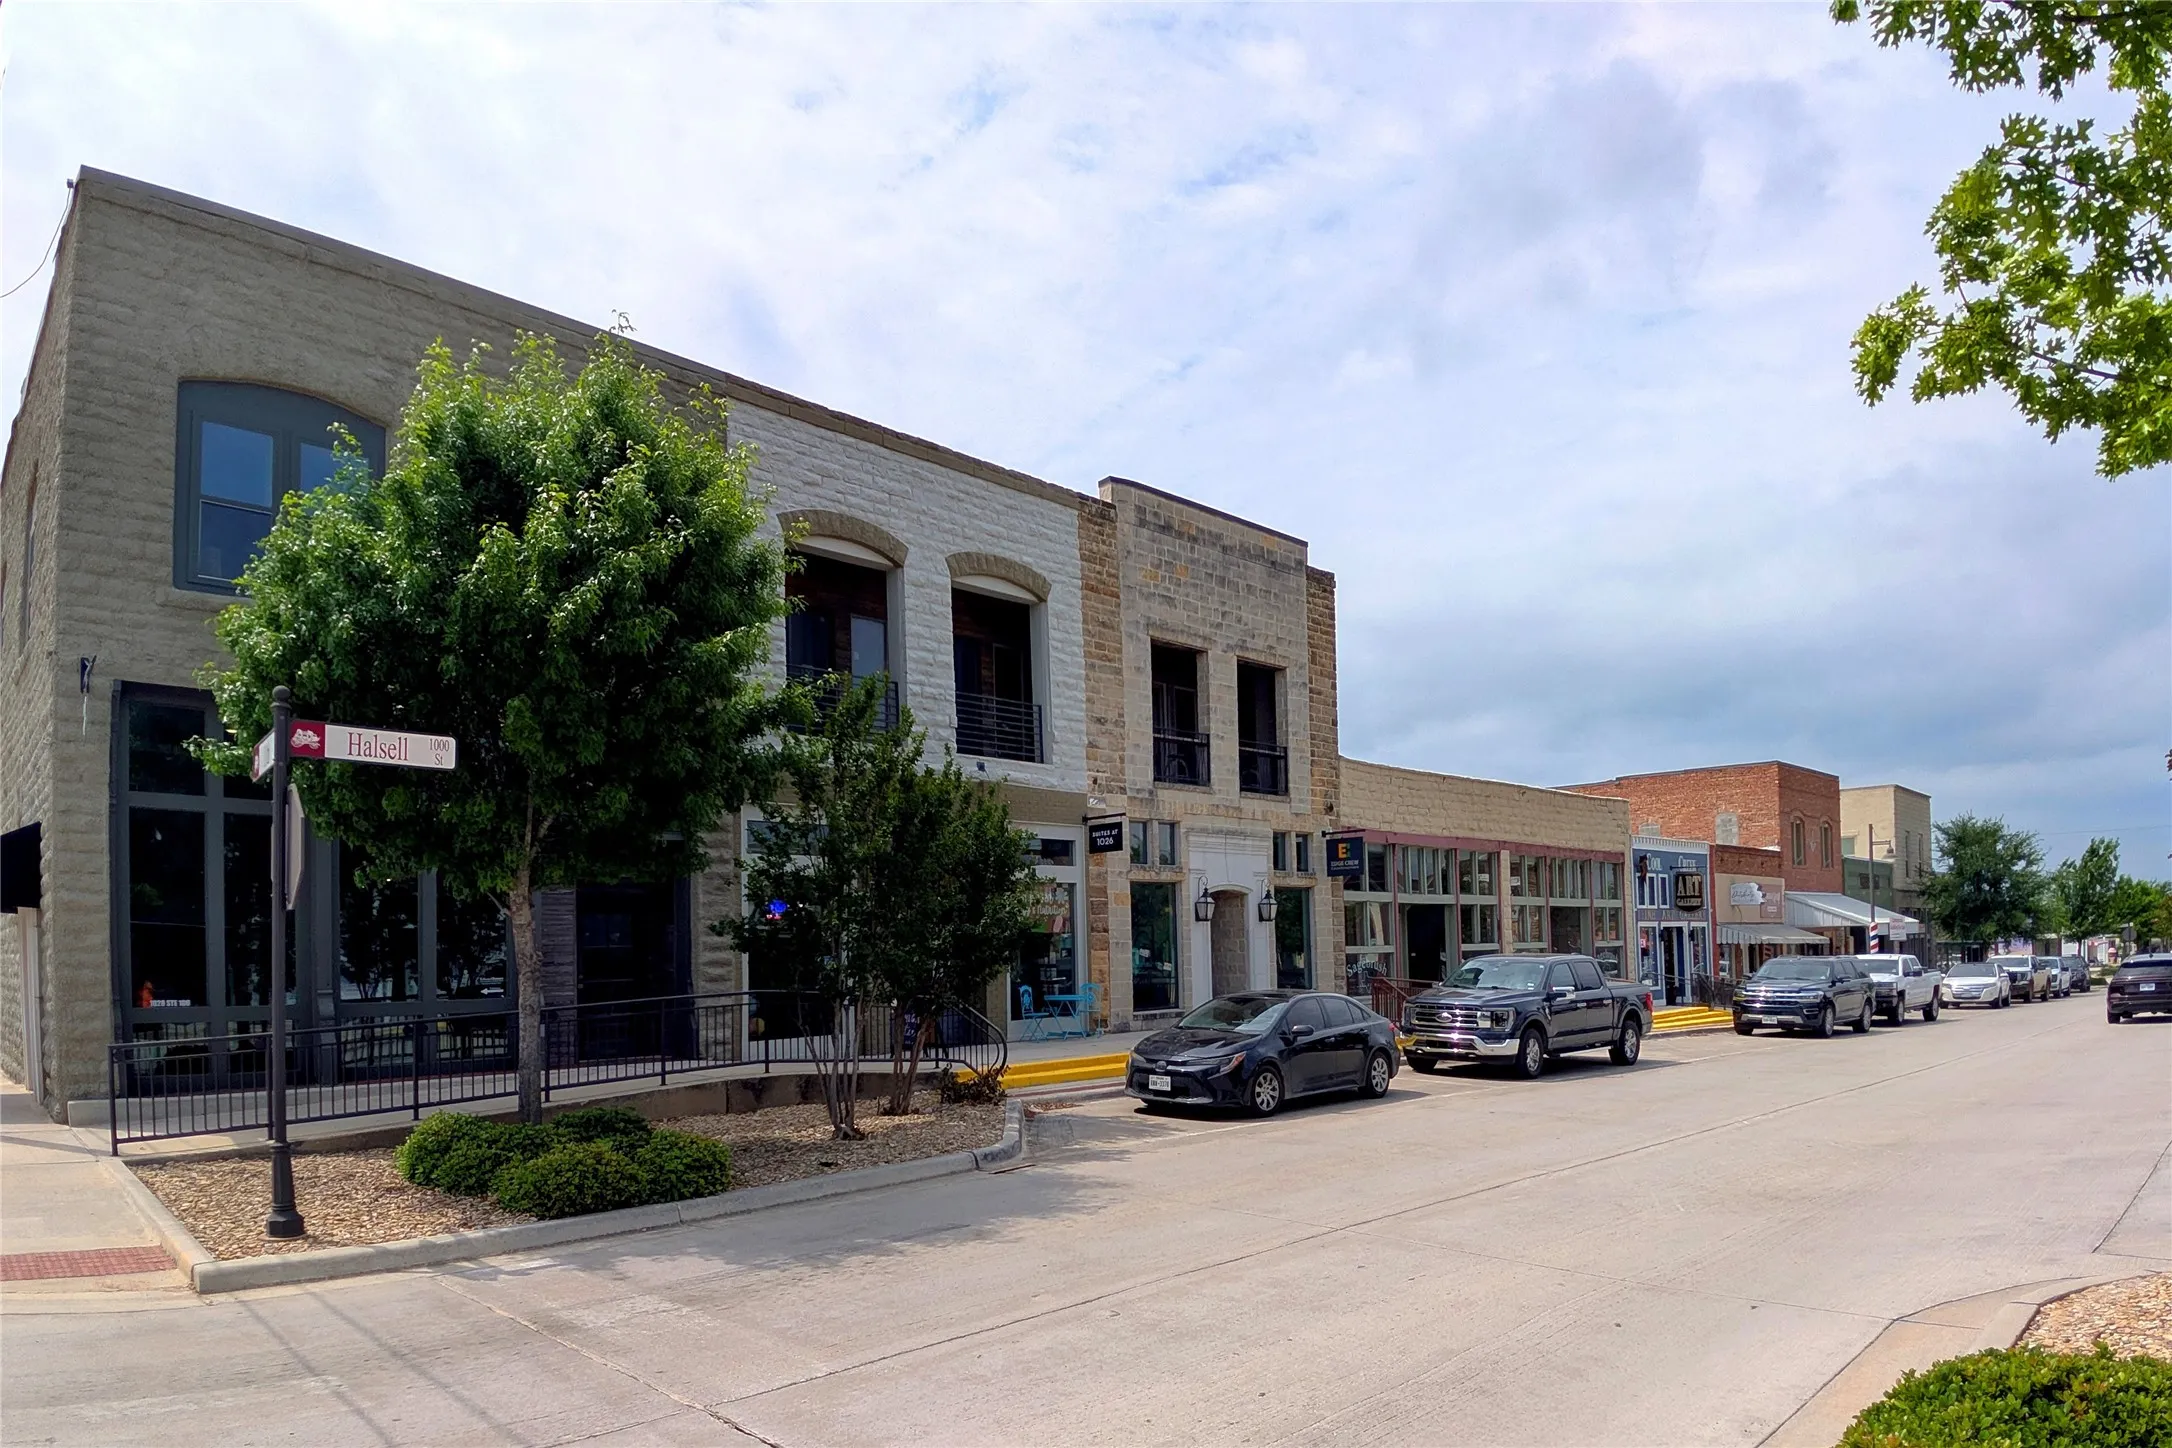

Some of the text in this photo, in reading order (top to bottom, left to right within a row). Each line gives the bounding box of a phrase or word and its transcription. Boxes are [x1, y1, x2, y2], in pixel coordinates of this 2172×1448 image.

[347, 732, 408, 761] Halsell
[429, 738, 450, 752] 1000
[434, 753, 443, 766] St
[1096, 837, 1114, 846] 1026
[1676, 875, 1702, 896] ART
[1346, 961, 1387, 977] Sagebrush
